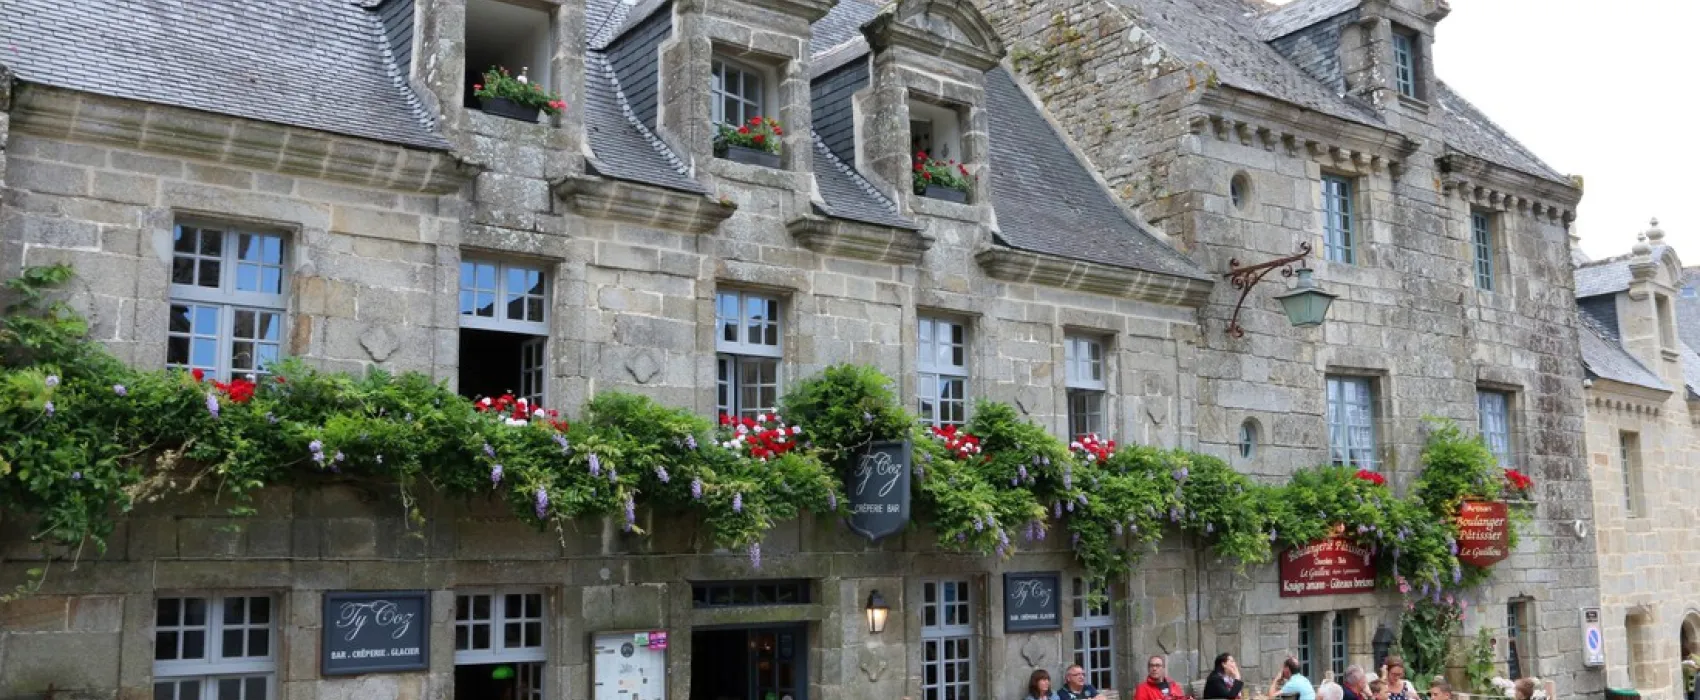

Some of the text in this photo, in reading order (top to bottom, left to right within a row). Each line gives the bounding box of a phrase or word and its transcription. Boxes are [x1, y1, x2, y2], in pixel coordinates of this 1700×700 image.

[855, 451, 902, 497] Ty Coz
[887, 503, 900, 513] BAR
[1457, 515, 1505, 532] Boulanger
[1460, 547, 1471, 556] Le
[1010, 580, 1030, 609] Ty
[336, 599, 415, 641] Ty Coz
[331, 650, 347, 660] BAR
[390, 647, 420, 657] GLACIER
